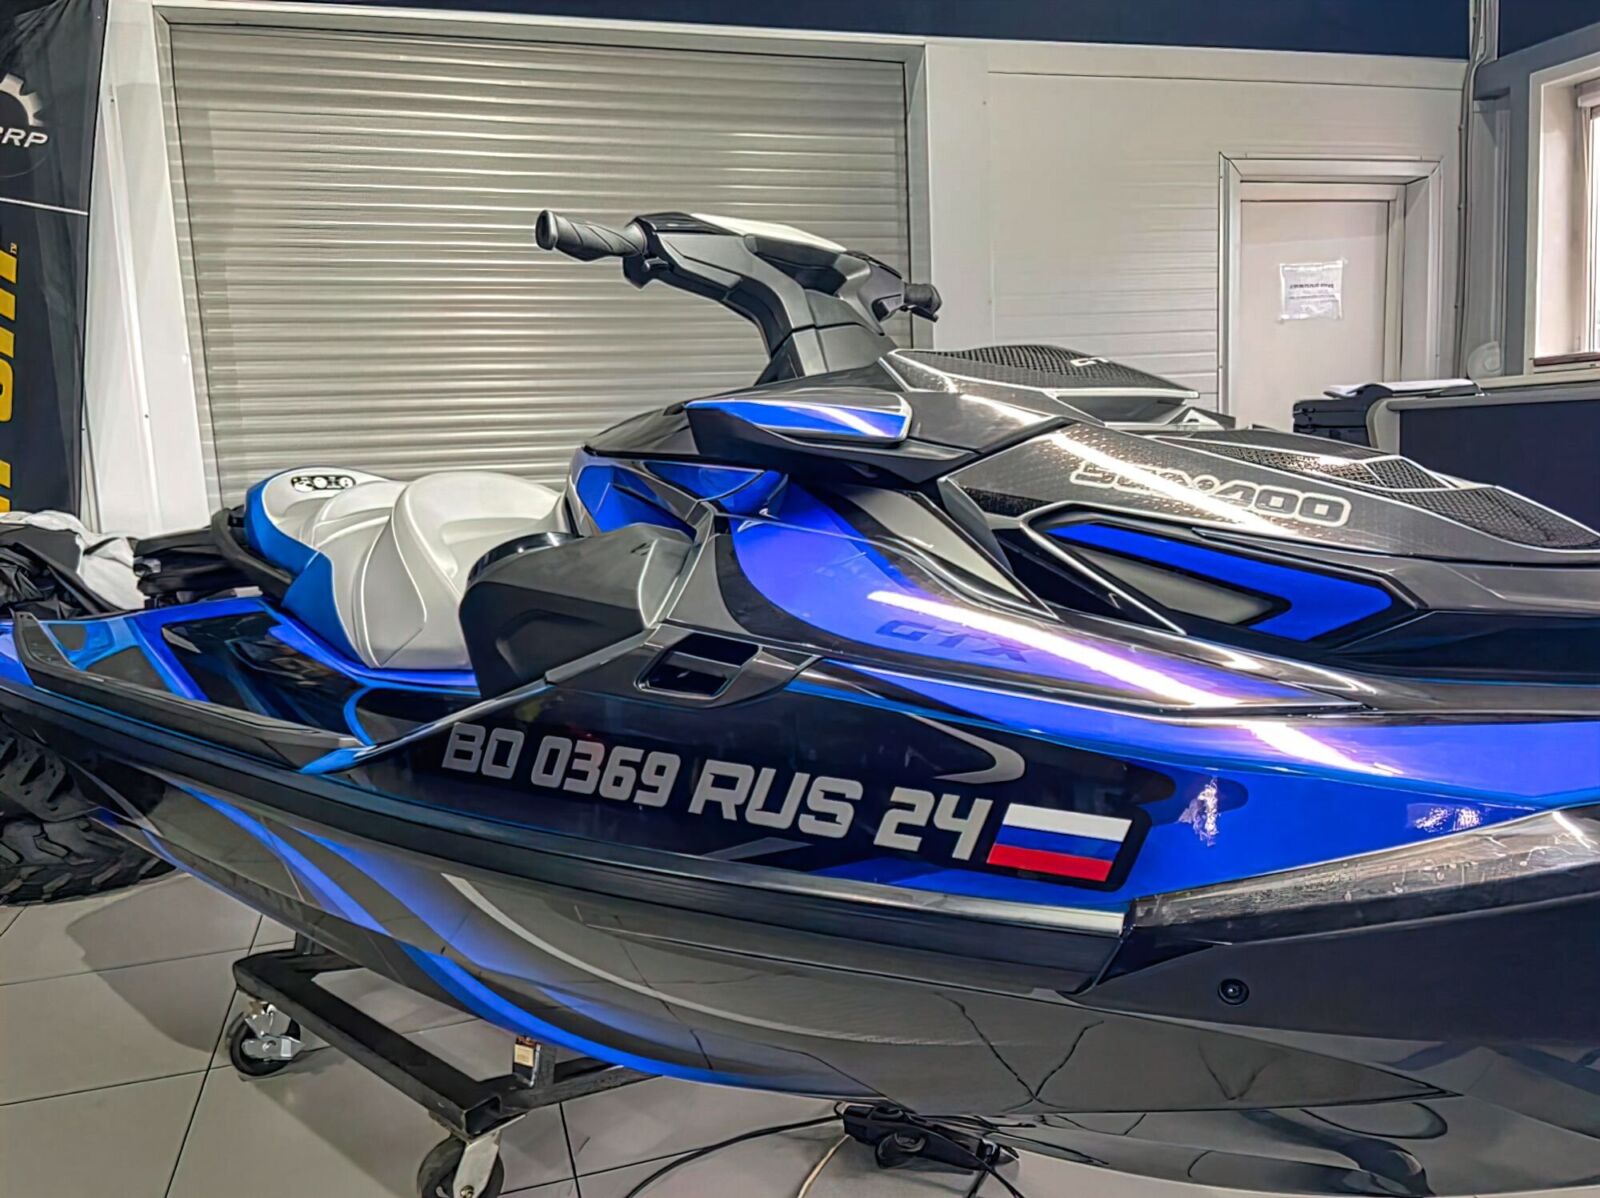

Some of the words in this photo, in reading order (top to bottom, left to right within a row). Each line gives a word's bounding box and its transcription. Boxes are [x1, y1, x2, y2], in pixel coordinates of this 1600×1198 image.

[0, 127, 48, 147] RP
[875, 620, 1027, 663] GTX
[442, 722, 525, 779] BO
[530, 735, 681, 807] 0369
[688, 759, 864, 839] RUS
[873, 786, 993, 861] 24
